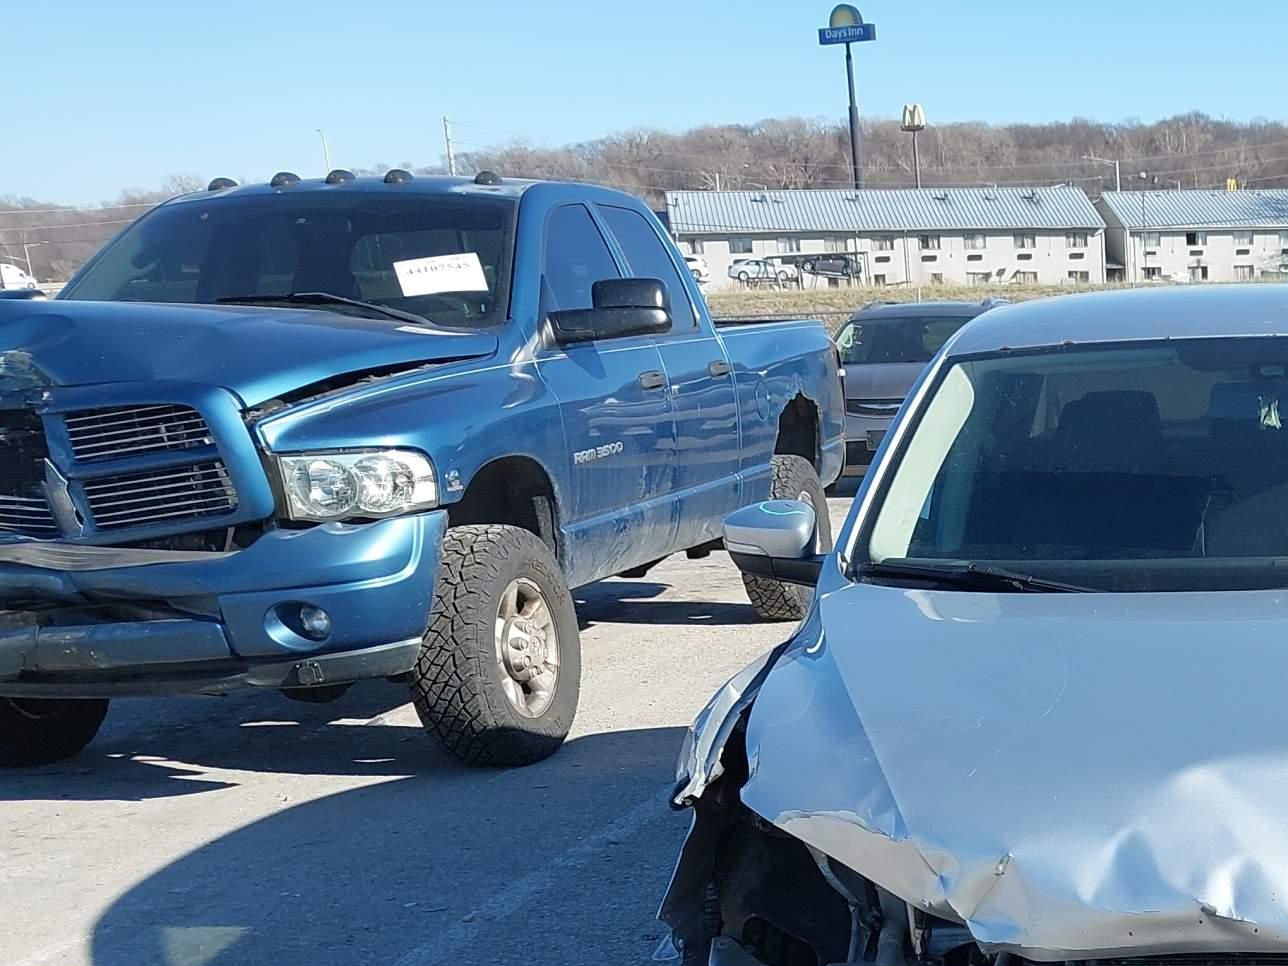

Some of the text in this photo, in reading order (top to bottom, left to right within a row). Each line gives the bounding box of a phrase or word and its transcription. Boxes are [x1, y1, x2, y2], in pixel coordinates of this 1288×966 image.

[824, 27, 864, 39] Days Inn
[574, 441, 624, 465] RAM 3500
